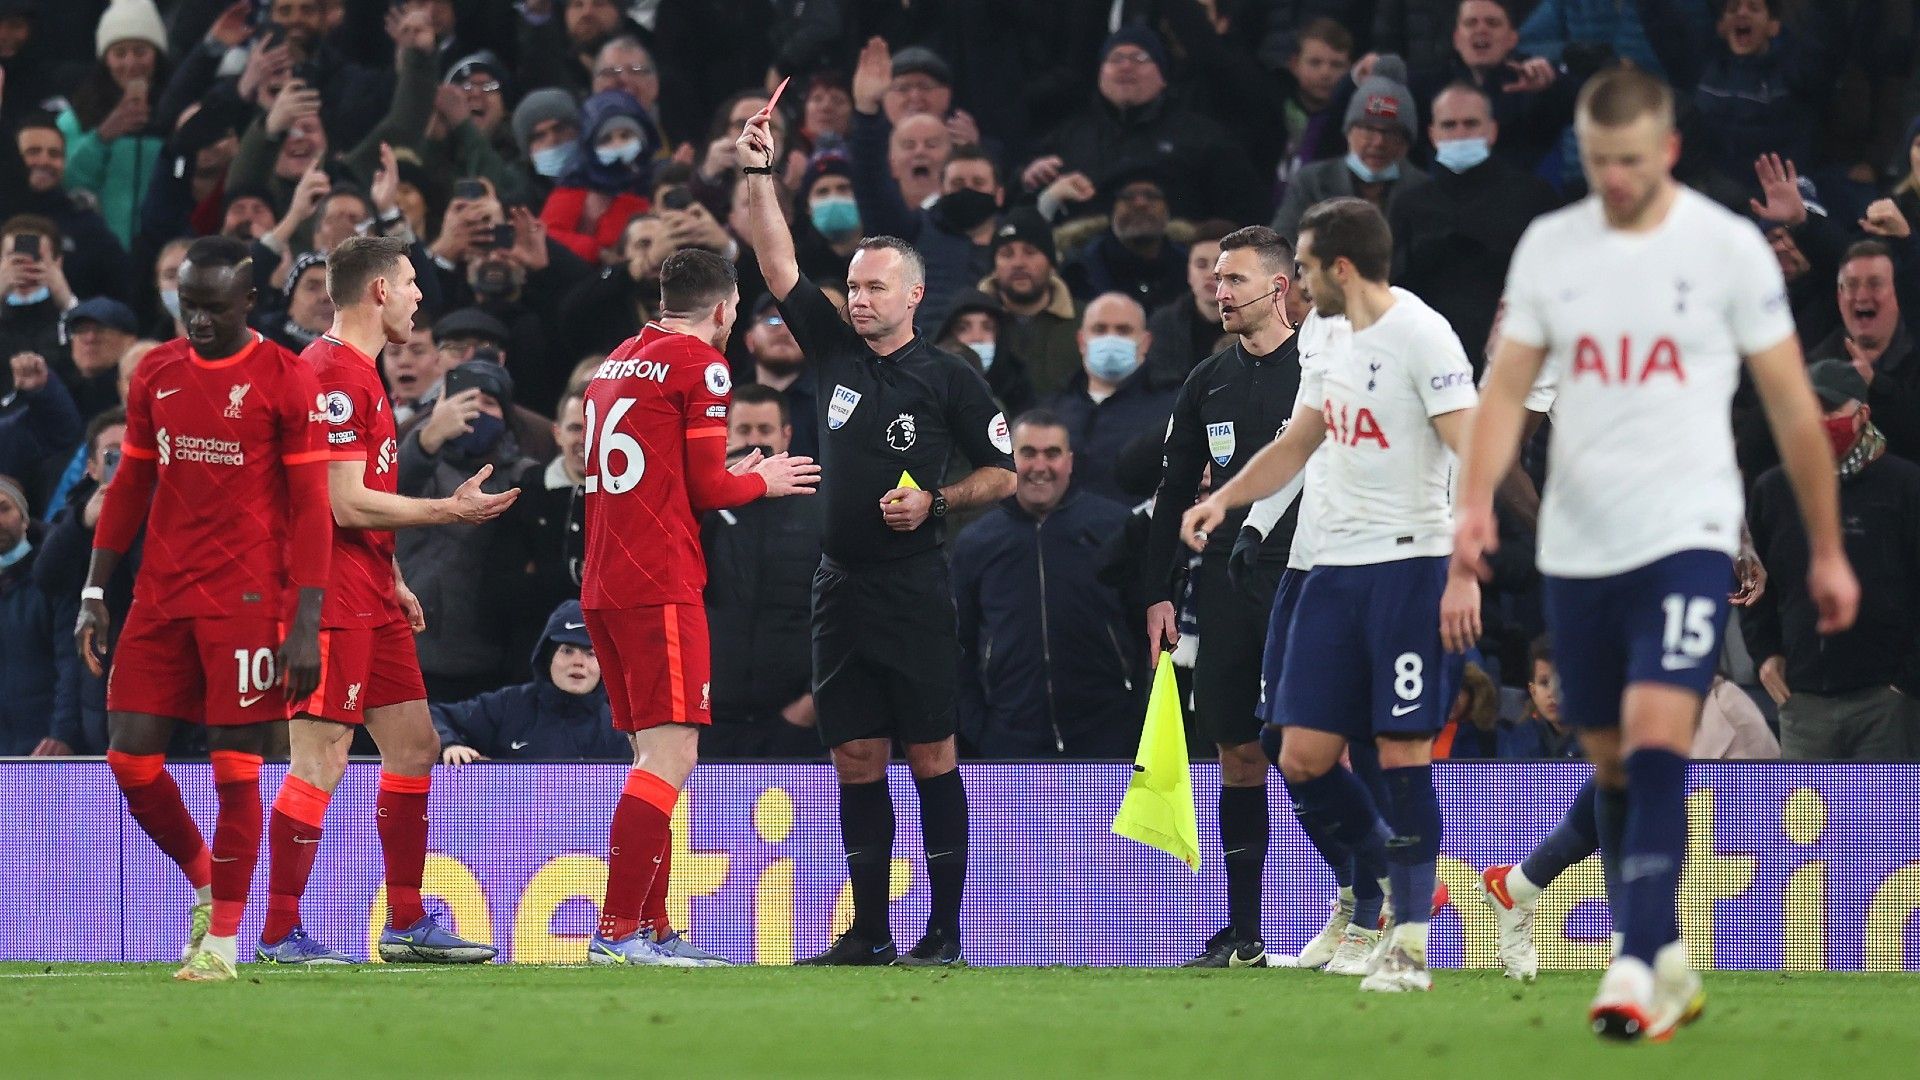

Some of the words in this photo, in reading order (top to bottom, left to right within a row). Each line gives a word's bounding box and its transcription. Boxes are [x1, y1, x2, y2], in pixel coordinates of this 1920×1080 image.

[1571, 332, 1688, 387] AIA
[835, 388, 857, 404] FIFA
[223, 409, 242, 419] LFC
[1209, 425, 1231, 437] FIFA
[175, 435, 240, 453] standard
[585, 398, 645, 495] 26
[175, 448, 244, 466] chartered
[1661, 593, 1716, 659] 15
[234, 647, 275, 694] 10
[1394, 651, 1424, 701] 8
[343, 702, 357, 711] LFC
